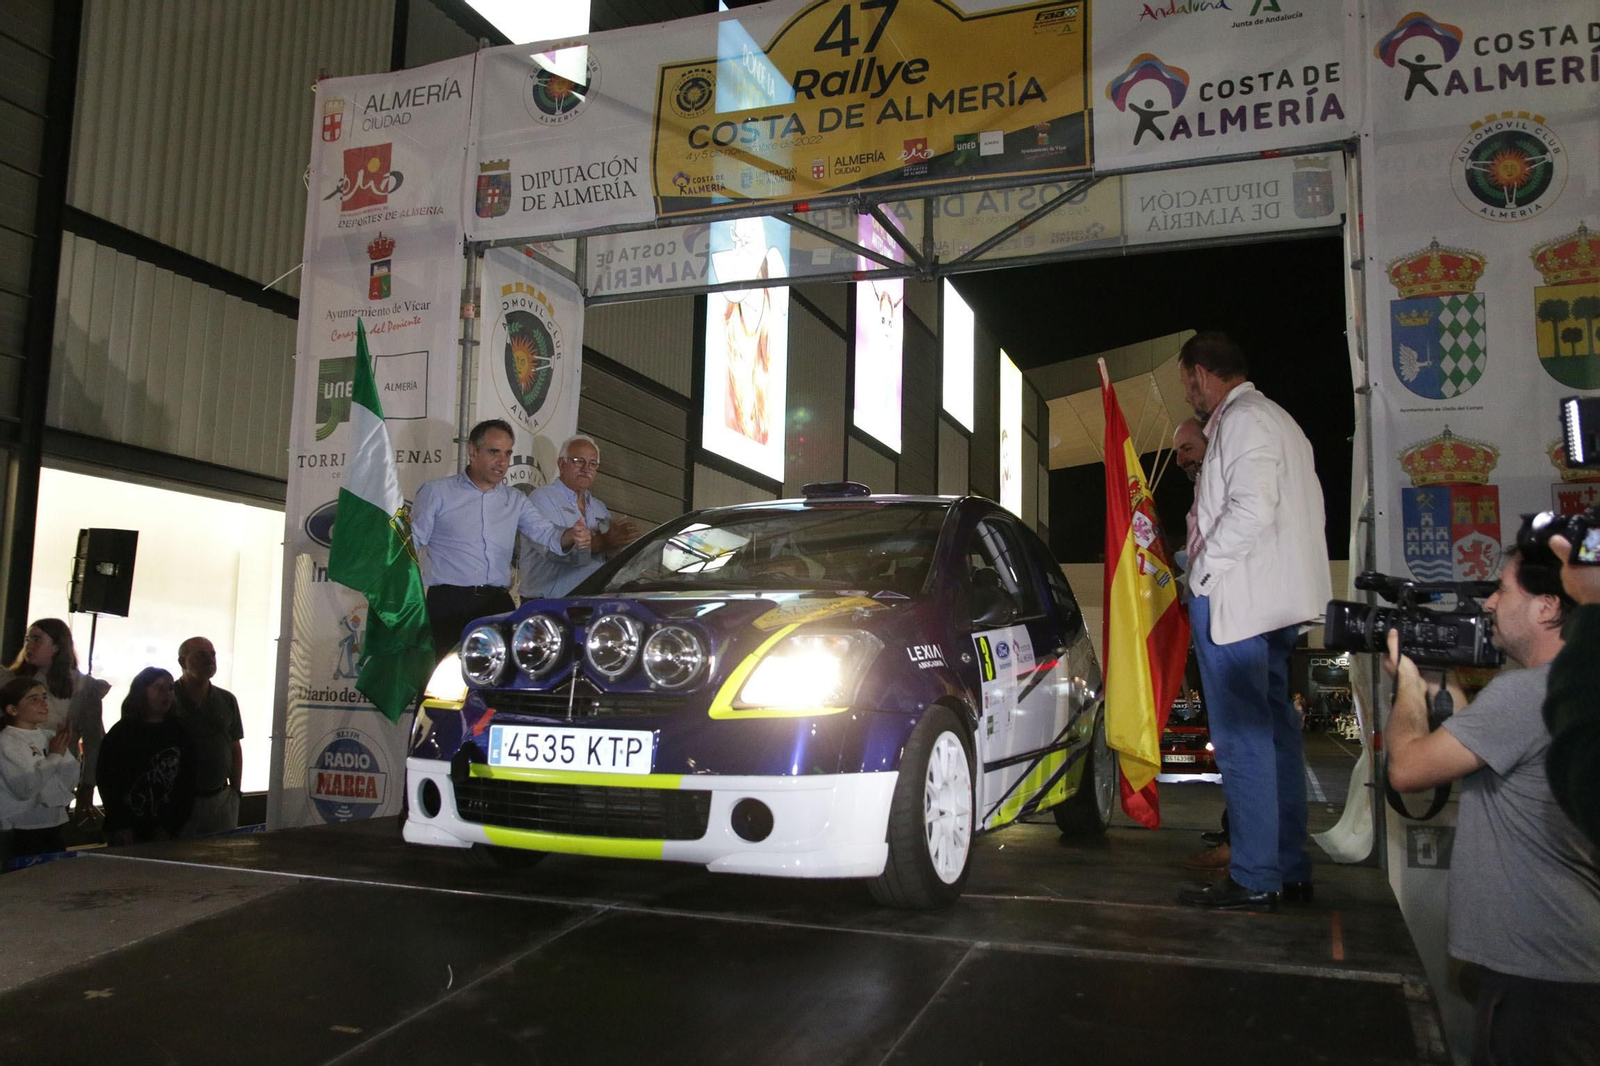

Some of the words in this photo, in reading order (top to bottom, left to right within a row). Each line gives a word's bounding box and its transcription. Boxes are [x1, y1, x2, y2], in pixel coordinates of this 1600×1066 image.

[813, 0, 899, 57] 47
[1231, 20, 1253, 28] Junta
[1265, 11, 1303, 23] Andalucía
[1474, 24, 1578, 56] COSTA
[792, 56, 930, 100] Rallye
[1444, 44, 1600, 96] ALMERÍ
[1200, 69, 1294, 101] COSTA
[1303, 62, 1340, 87] DE
[363, 77, 462, 115] ALMERÍA
[539, 109, 579, 123] ALMERIA
[688, 113, 806, 150] COSTA
[818, 103, 866, 133] DE
[876, 71, 1047, 125] ALMERÍA
[1169, 87, 1345, 141] ALMERÍA
[362, 112, 412, 132] CIUDAD
[795, 135, 823, 147] 2022
[1458, 121, 1527, 163] AUTOMOVIL
[1535, 127, 1561, 155] CLUB
[834, 150, 886, 167] ALMERÍA
[521, 155, 638, 191] DIPUTACIÓN
[692, 174, 715, 184] COSTA
[834, 166, 861, 176] CIUDAD
[522, 194, 547, 212] DE
[552, 176, 637, 209] ALMERÍA
[688, 182, 727, 195] ALMERÍA
[338, 213, 383, 229] DEPORTES
[385, 210, 398, 221] DE
[1481, 203, 1542, 218] ALMERIA
[392, 302, 402, 314] de
[404, 300, 431, 312] Vícar
[370, 322, 386, 335] del
[388, 315, 421, 332] Poniente
[324, 380, 353, 399] UNE
[384, 381, 418, 391] ALMERÍA
[907, 644, 942, 661] LEXIA
[339, 686, 357, 703] de
[492, 750, 499, 759] E
[508, 732, 576, 764] 4535
[587, 736, 643, 767] KTP
[324, 752, 371, 769] RADIO
[316, 772, 378, 799] MARCA
